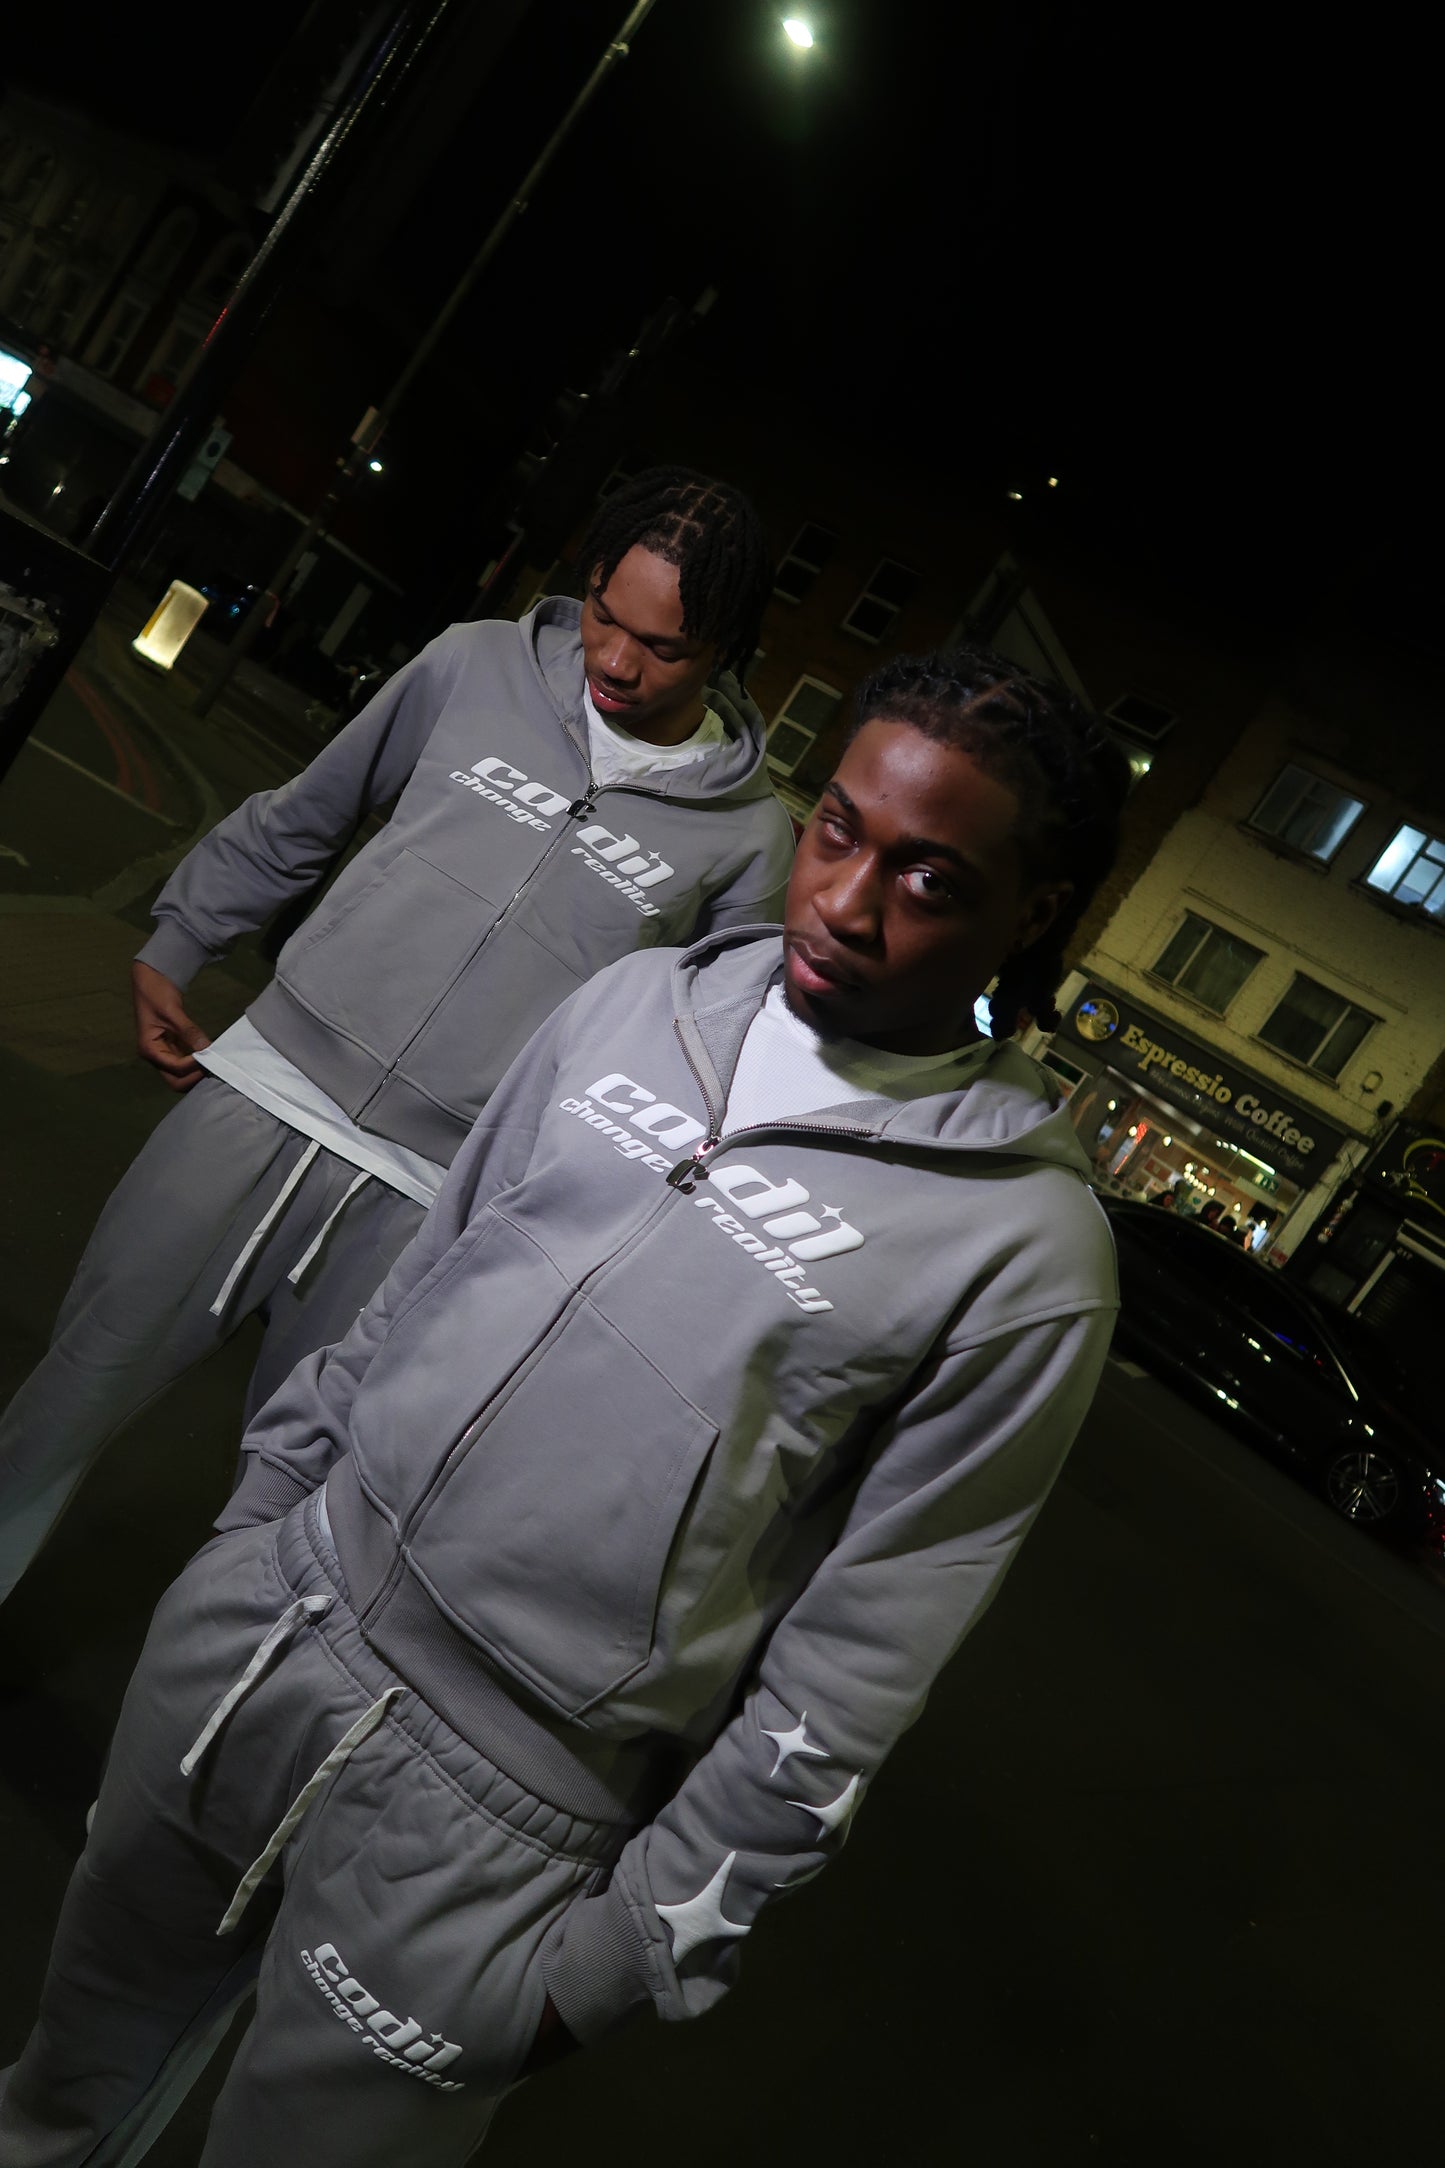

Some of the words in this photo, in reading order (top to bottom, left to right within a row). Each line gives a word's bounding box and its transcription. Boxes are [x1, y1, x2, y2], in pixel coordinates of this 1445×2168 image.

[448, 770, 552, 832] change
[570, 847, 661, 917] reality
[1119, 1023, 1232, 1104] Espressio
[1234, 1093, 1316, 1155] Coffee
[559, 1097, 674, 1173] change
[694, 1197, 834, 1314] reality
